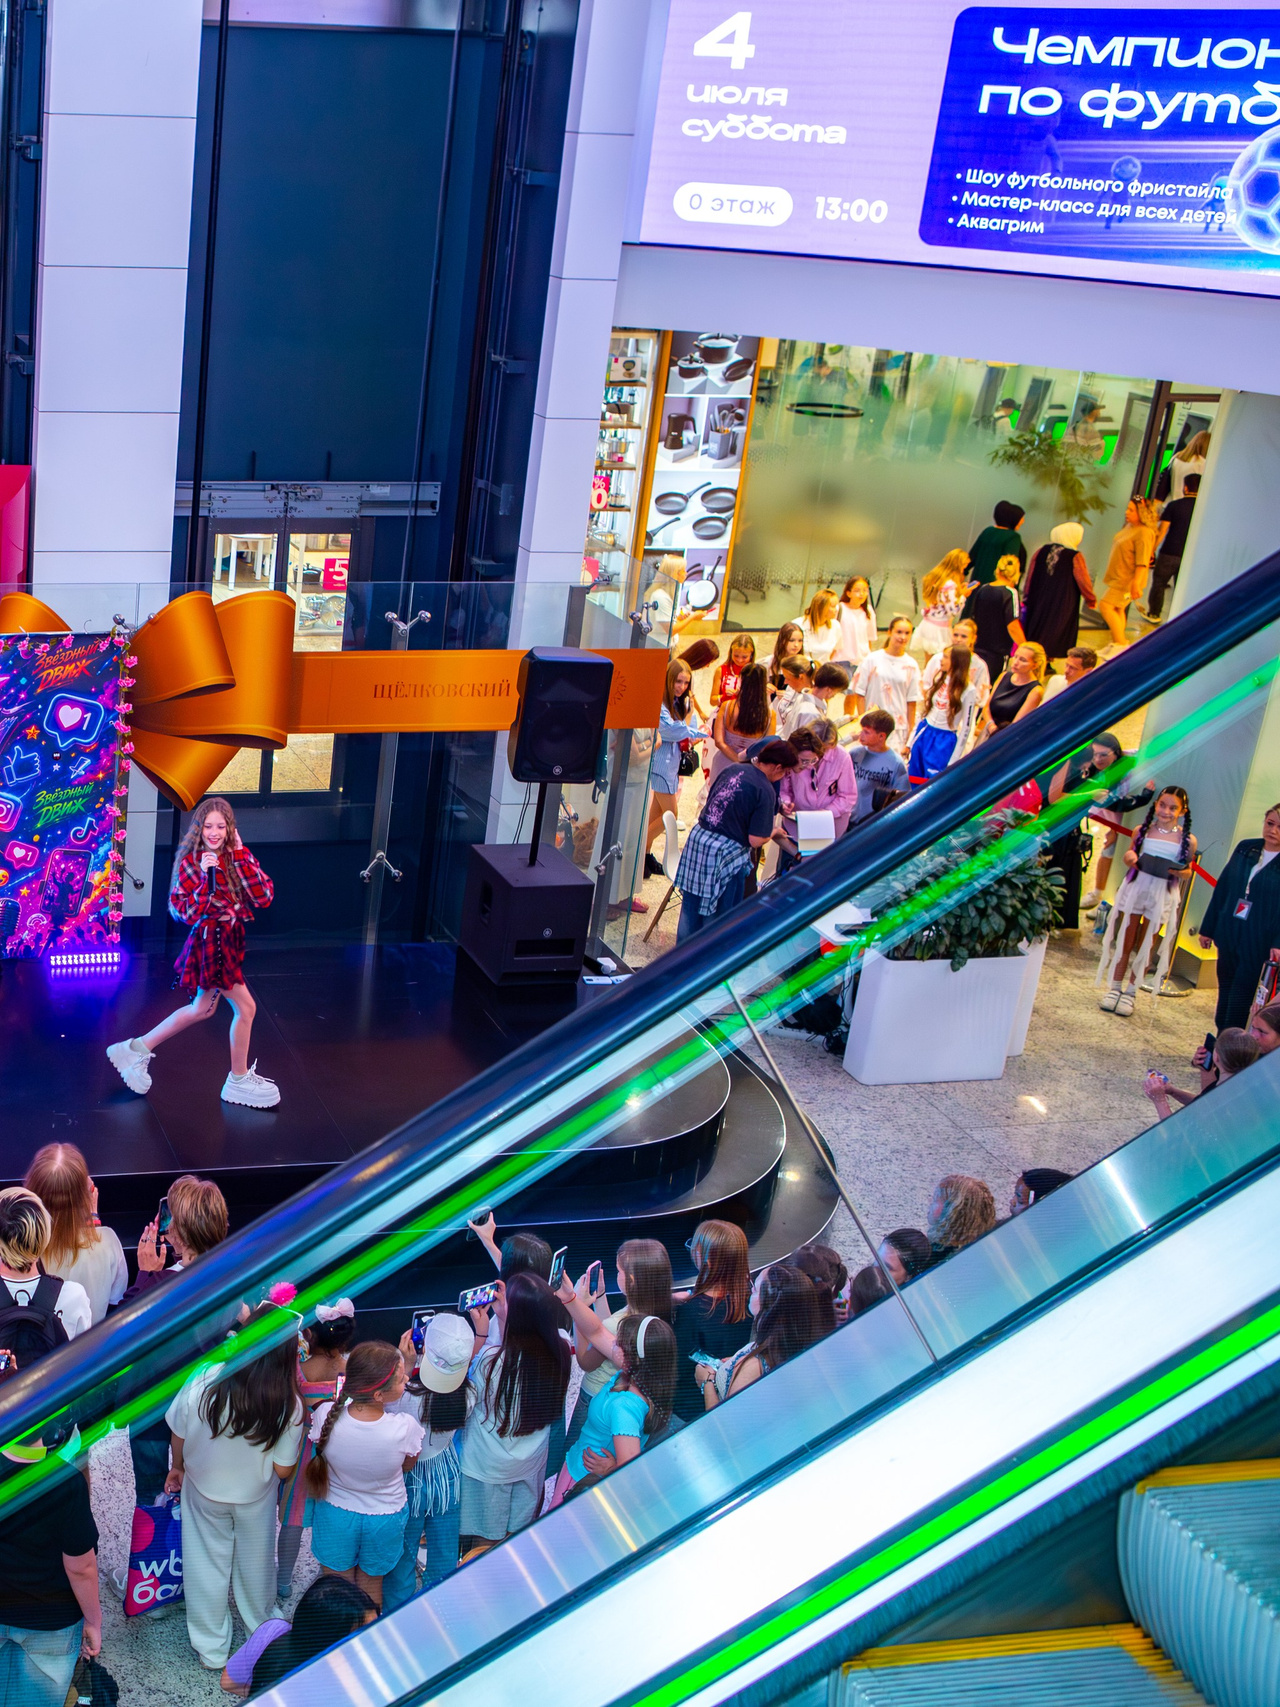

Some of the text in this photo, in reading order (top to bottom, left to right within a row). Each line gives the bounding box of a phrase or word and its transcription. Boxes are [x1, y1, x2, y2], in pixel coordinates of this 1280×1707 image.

[693, 12, 755, 69] 4
[992, 27, 1280, 69] Чемпион
[687, 84, 788, 106] июля
[979, 80, 1280, 130] по футб
[682, 113, 847, 144] суббота
[966, 169, 1233, 200] Шоу футбольного фристайла
[689, 194, 775, 214] 0 этаж
[815, 196, 888, 223] 13:00
[961, 191, 1237, 225] Мастер-класс для всех детей
[957, 213, 1044, 234] Аквагрим
[34, 658, 100, 695] ДВИЖ
[373, 679, 511, 700] ЩЁЛКОВСКИЙ
[33, 798, 93, 830] ДВИЖ
